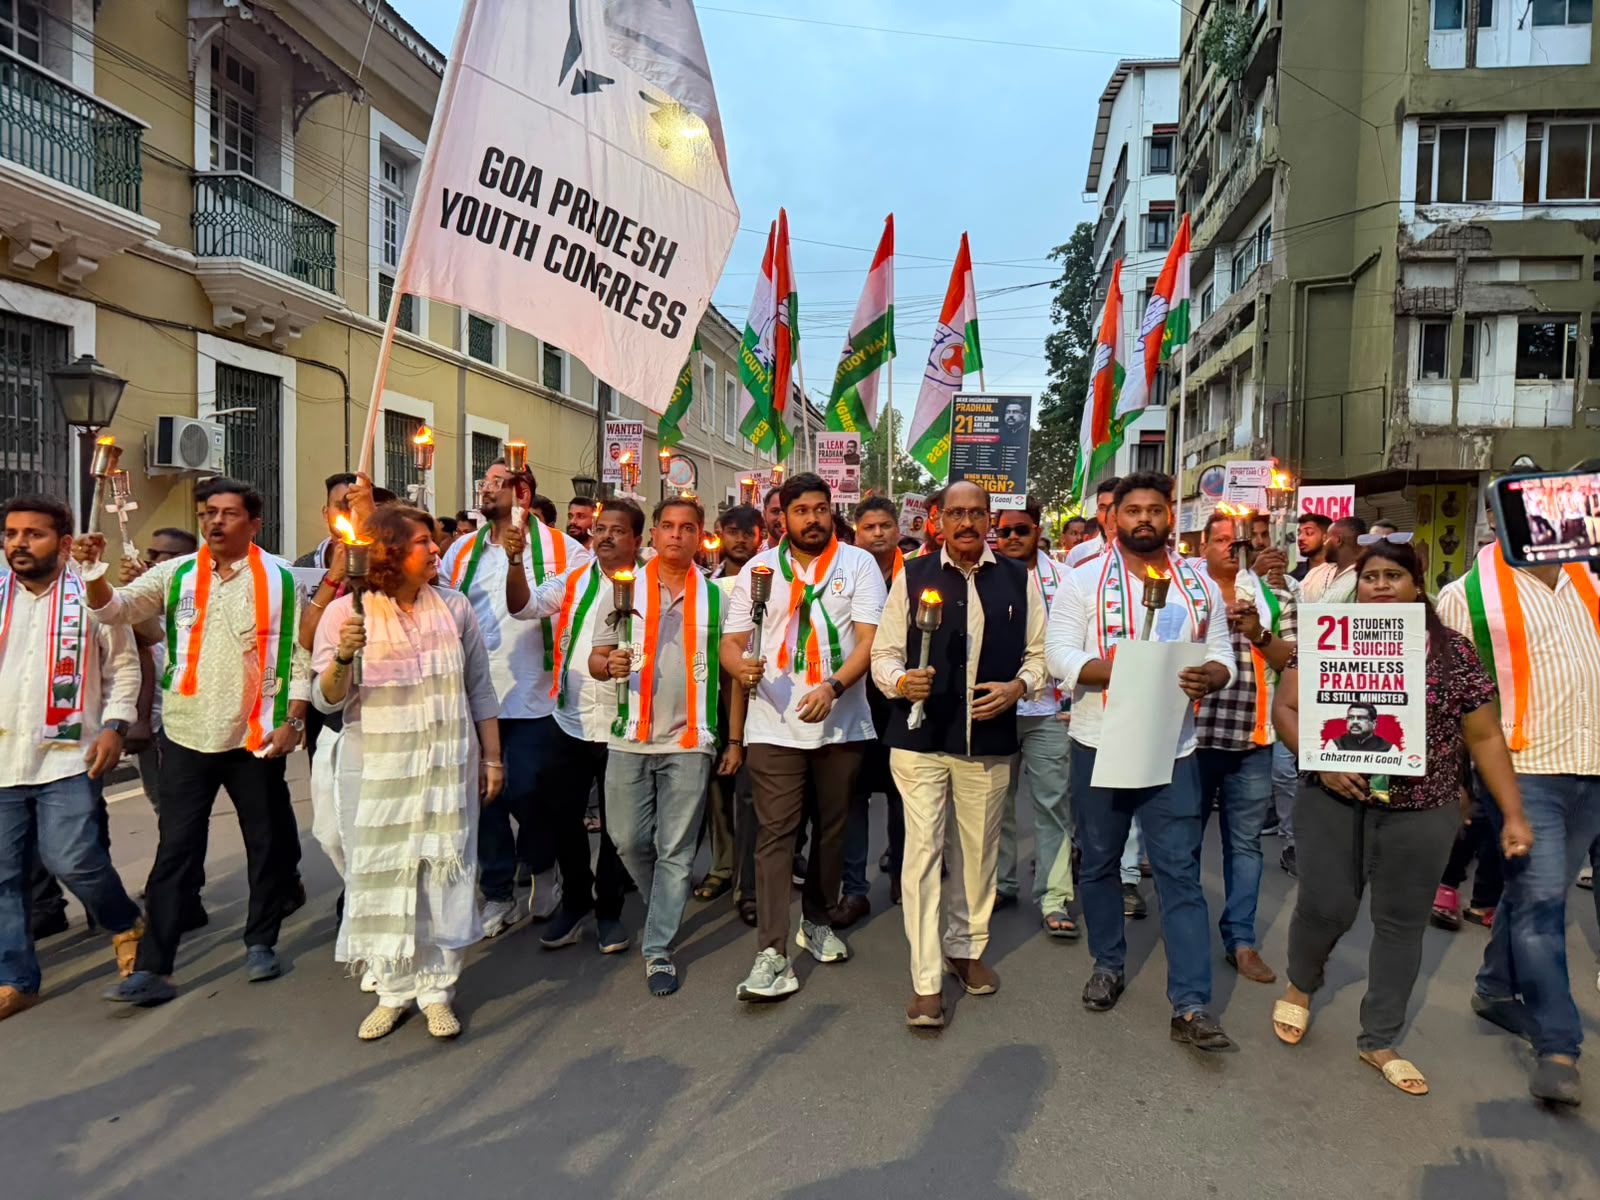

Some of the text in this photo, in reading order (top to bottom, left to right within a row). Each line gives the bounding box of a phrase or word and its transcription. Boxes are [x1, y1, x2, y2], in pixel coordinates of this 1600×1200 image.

[478, 146, 679, 280] GOA PRADESH
[439, 187, 688, 340] YOUTH CONGRESS
[606, 423, 642, 434] WANTED
[954, 415, 973, 433] 21
[827, 440, 844, 450] LEAK
[1301, 495, 1352, 522] SACK
[1353, 618, 1404, 630] STUDENTS
[1317, 615, 1349, 650] 21
[1353, 630, 1404, 641] COMMITTED
[1353, 641, 1404, 656] SUICIDE
[1320, 661, 1404, 673] SHAMELESS
[1320, 673, 1405, 691] PRADHAN
[1321, 692, 1405, 704] IS STILL MINISTER
[1320, 752, 1402, 766] Chhatron Ki Goonj
